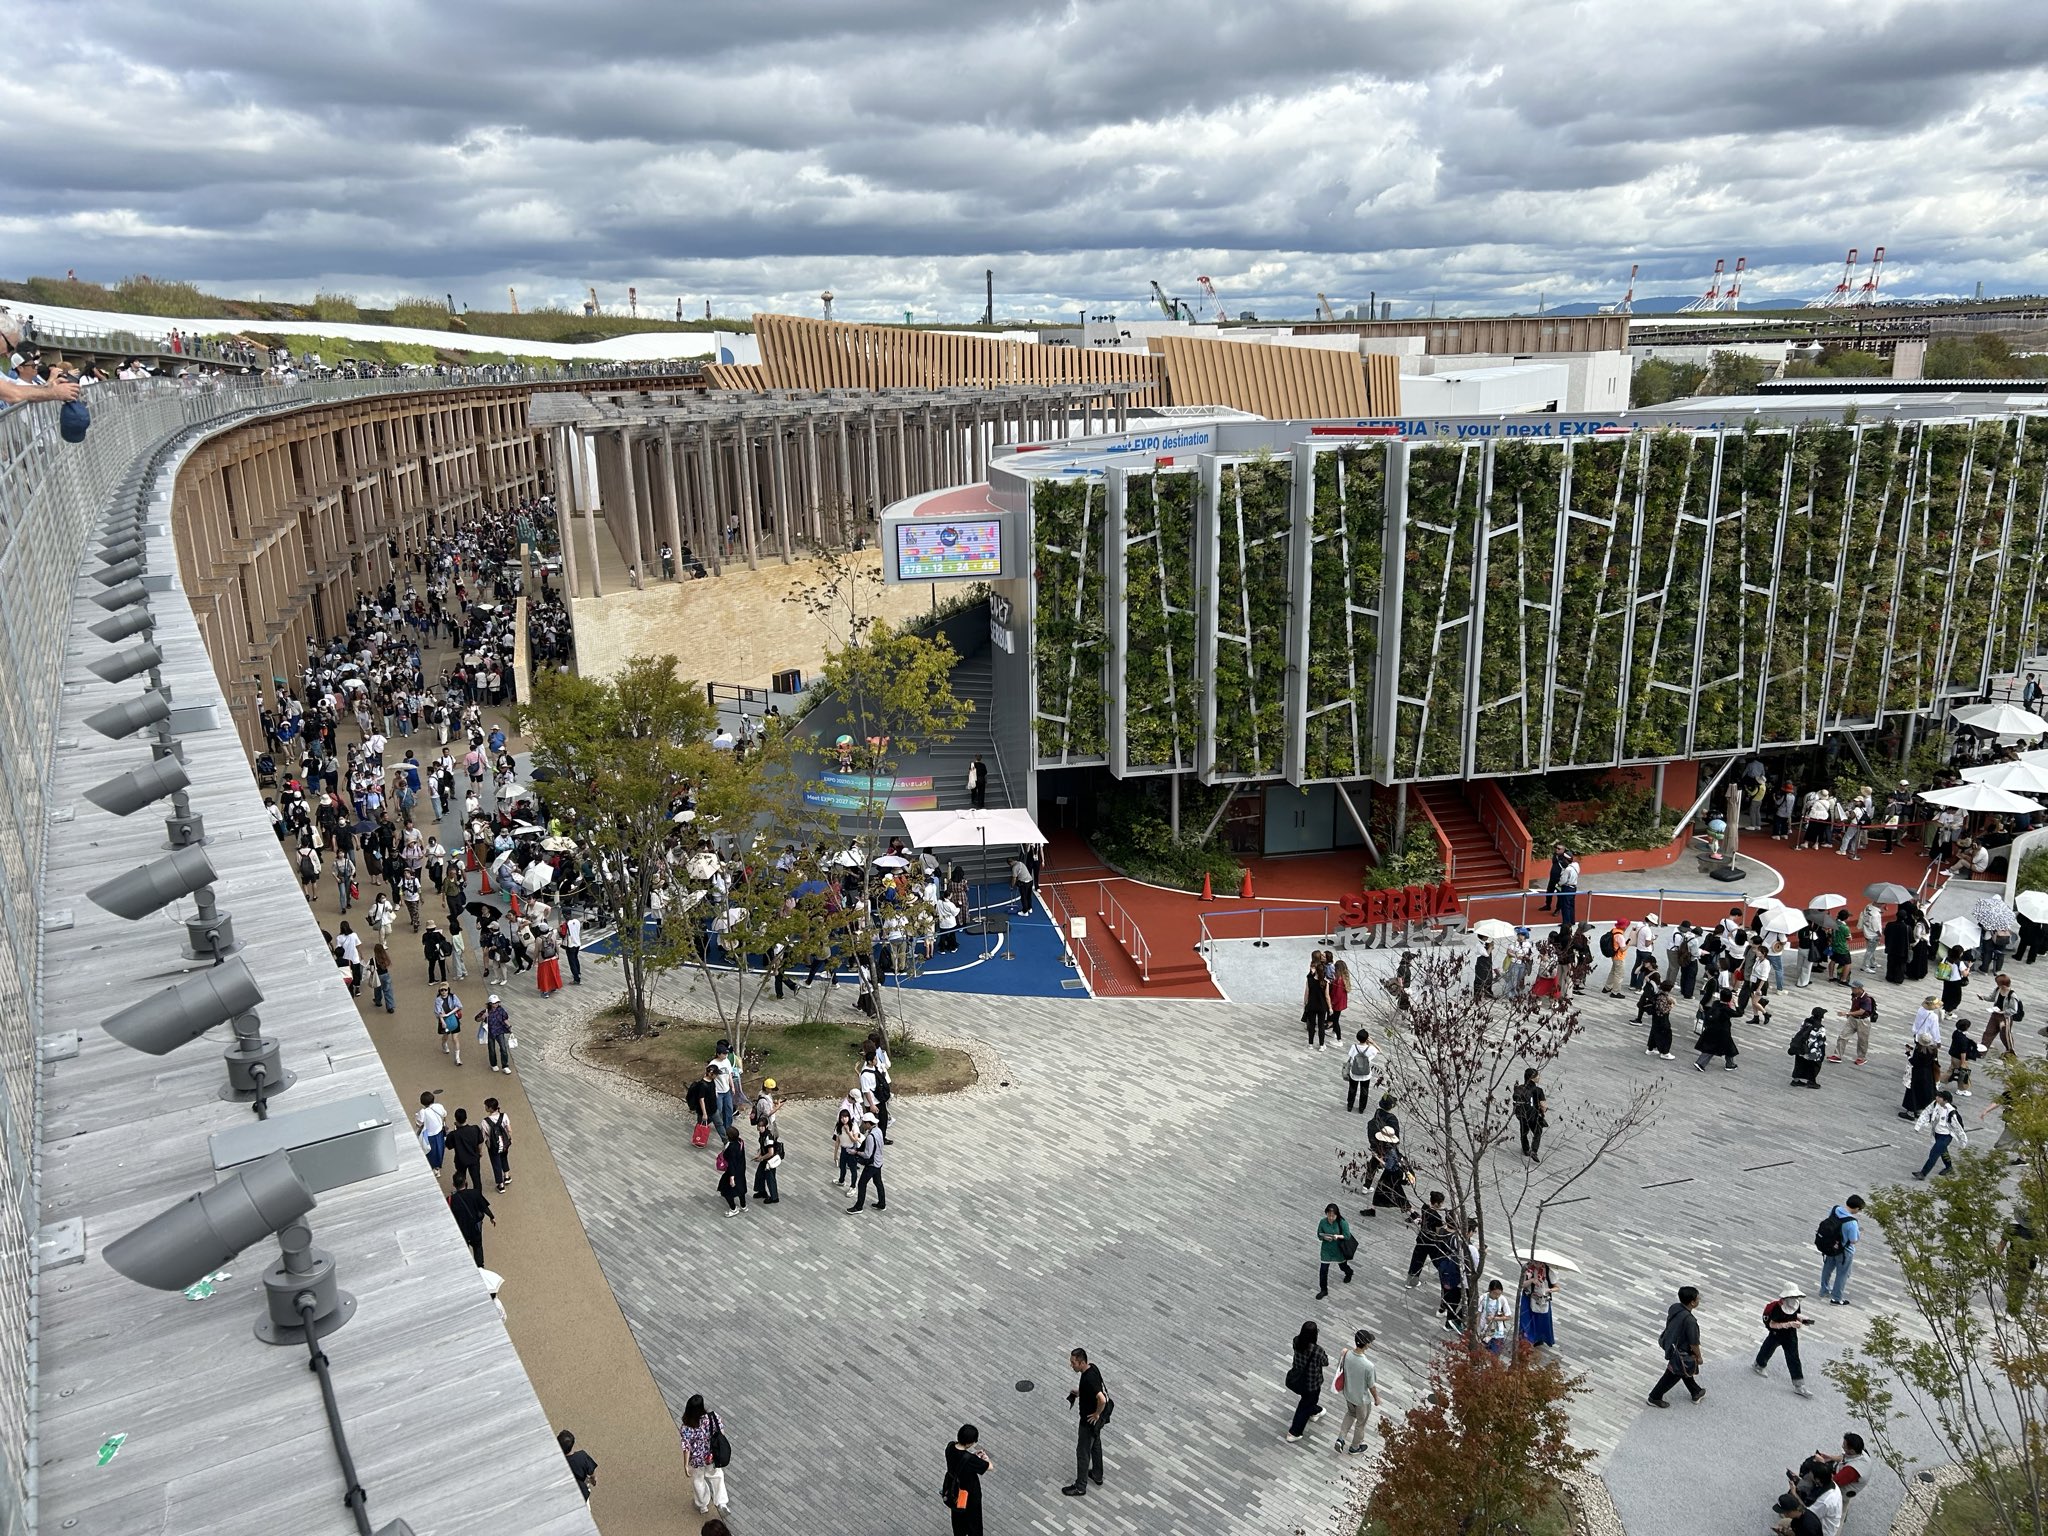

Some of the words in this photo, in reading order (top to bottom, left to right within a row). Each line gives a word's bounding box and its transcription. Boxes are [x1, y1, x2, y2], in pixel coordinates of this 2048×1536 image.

[1434, 421, 1450, 435] is
[1456, 425, 1500, 438] your
[1506, 422, 1551, 436] next
[1134, 436, 1160, 451] EXPO
[1162, 432, 1209, 450] destination
[904, 565, 922, 574] 578
[932, 564, 943, 573] 12
[957, 562, 969, 571] 24
[981, 561, 994, 570] 45
[823, 776, 836, 784] EXPO
[806, 794, 820, 802] Meet
[1339, 881, 1462, 926] SERBIA
[1335, 914, 1468, 951] セルビア
